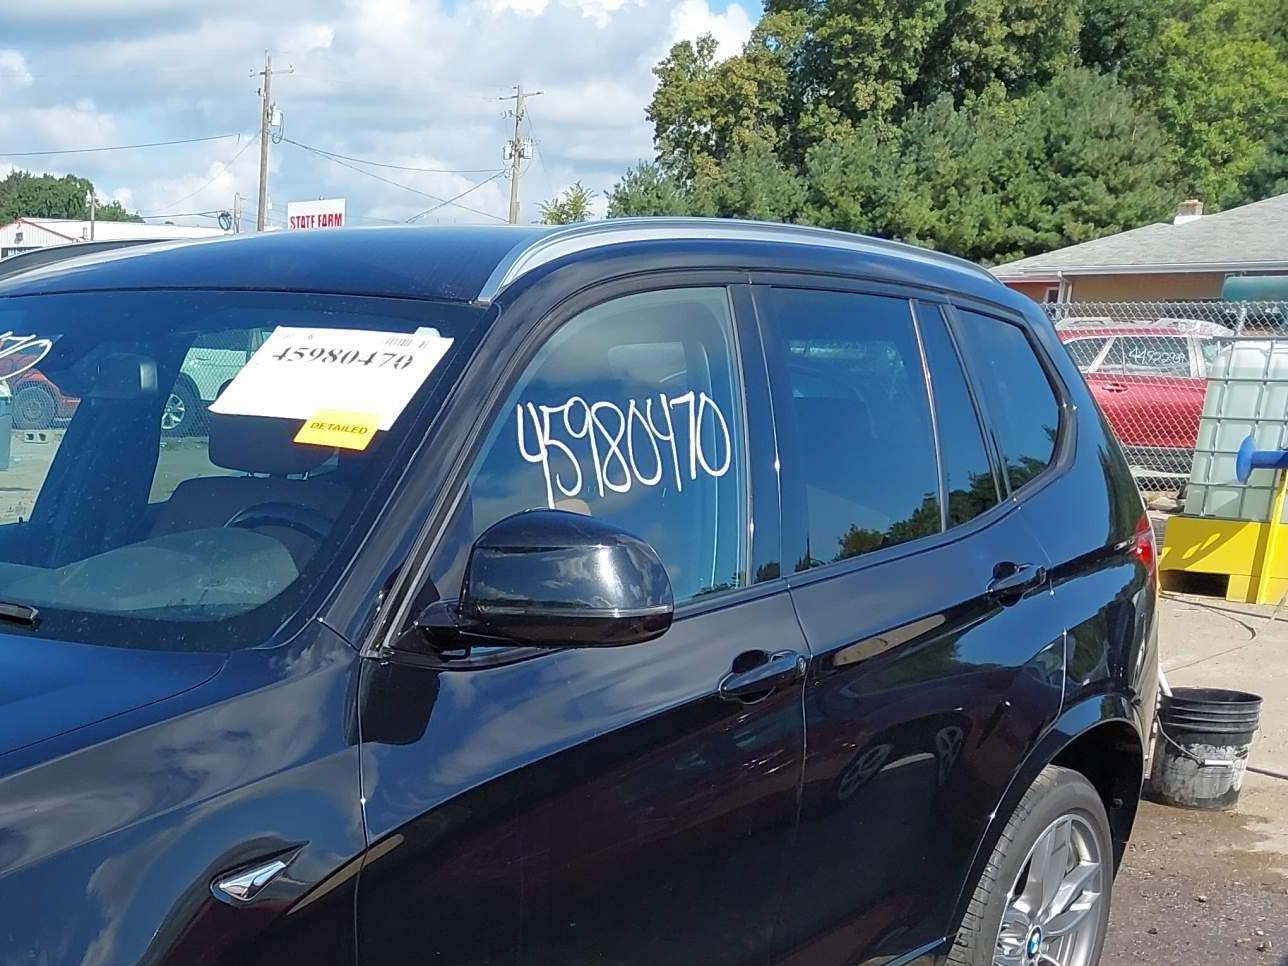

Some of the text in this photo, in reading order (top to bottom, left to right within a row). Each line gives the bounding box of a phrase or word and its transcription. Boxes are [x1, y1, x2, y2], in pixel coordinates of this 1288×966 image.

[290, 213, 343, 230] STATE FARM
[272, 346, 414, 370] 45980470
[309, 421, 368, 436] DETAILED
[516, 390, 732, 510] 45980470
